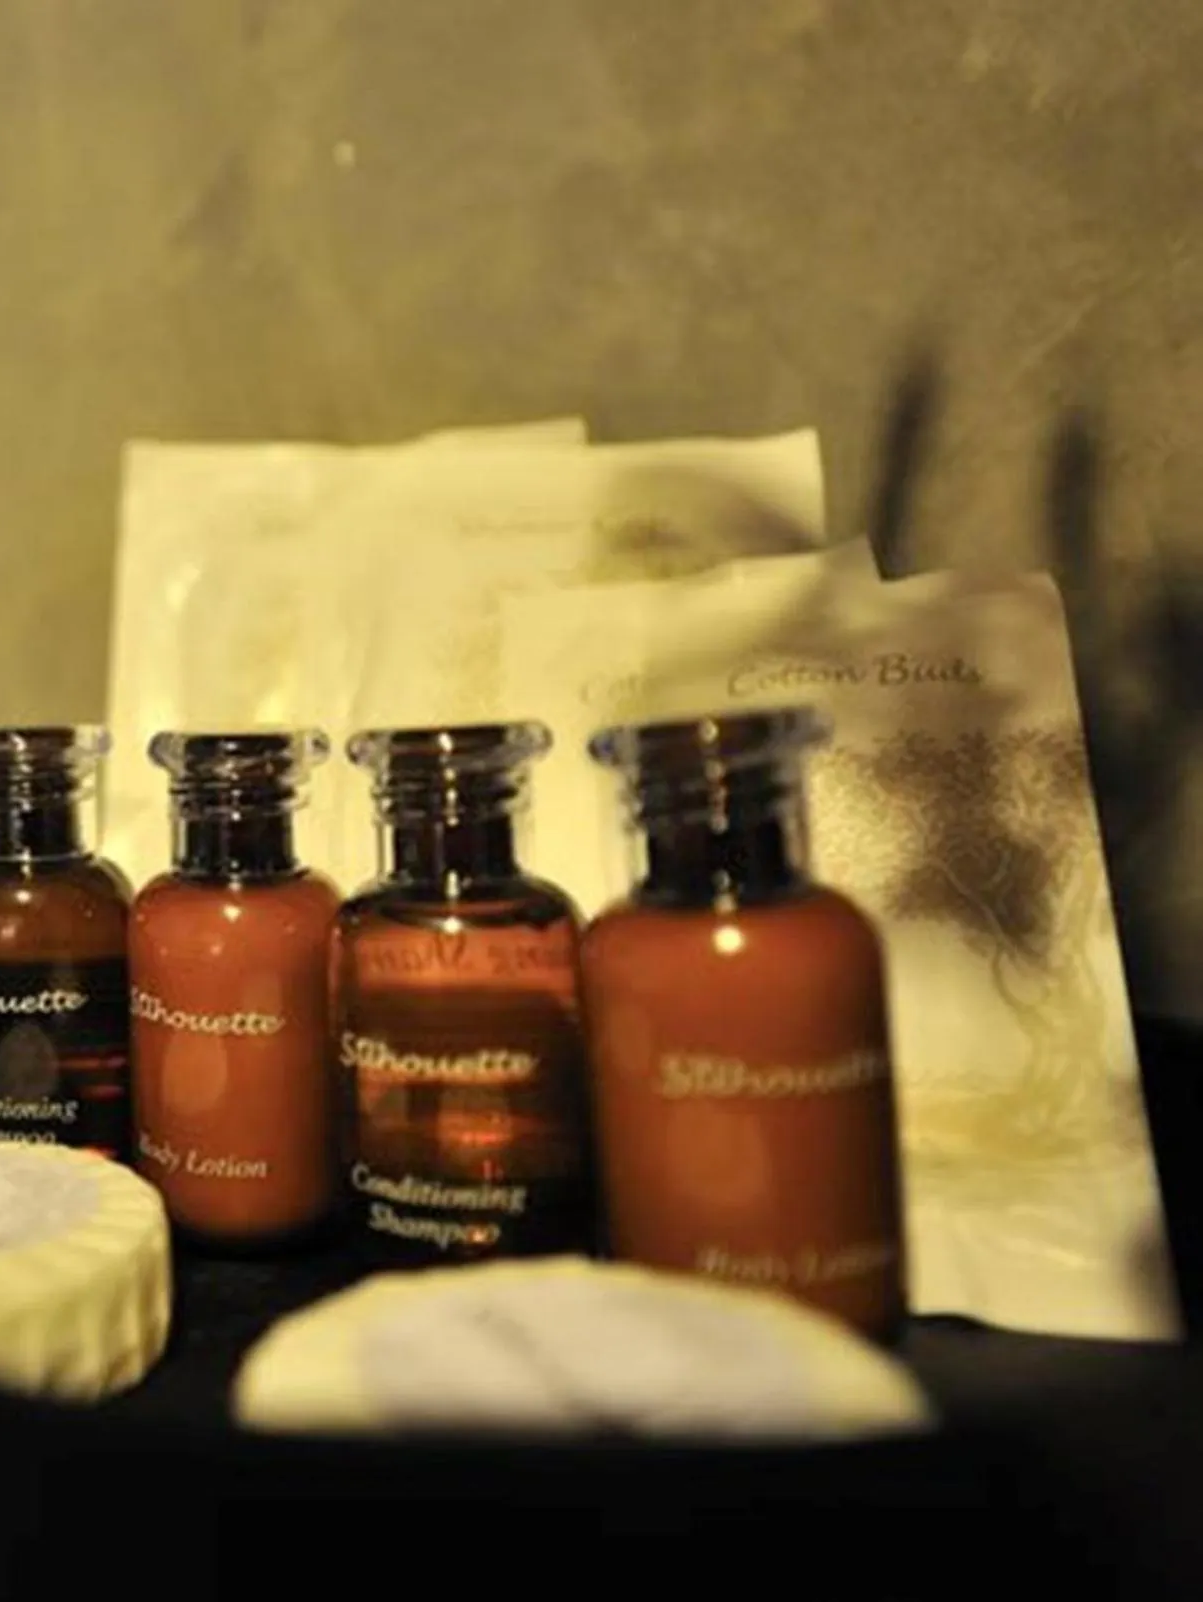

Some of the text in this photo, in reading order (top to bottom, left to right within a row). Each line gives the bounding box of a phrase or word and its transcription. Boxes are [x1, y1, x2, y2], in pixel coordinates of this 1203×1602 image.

[727, 652, 984, 698] Cotton Buds
[339, 1032, 538, 1078] Silhouette
[185, 1149, 267, 1178] Lotion
[351, 1162, 527, 1214] Conditioning
[367, 1202, 502, 1249] Shampoo
